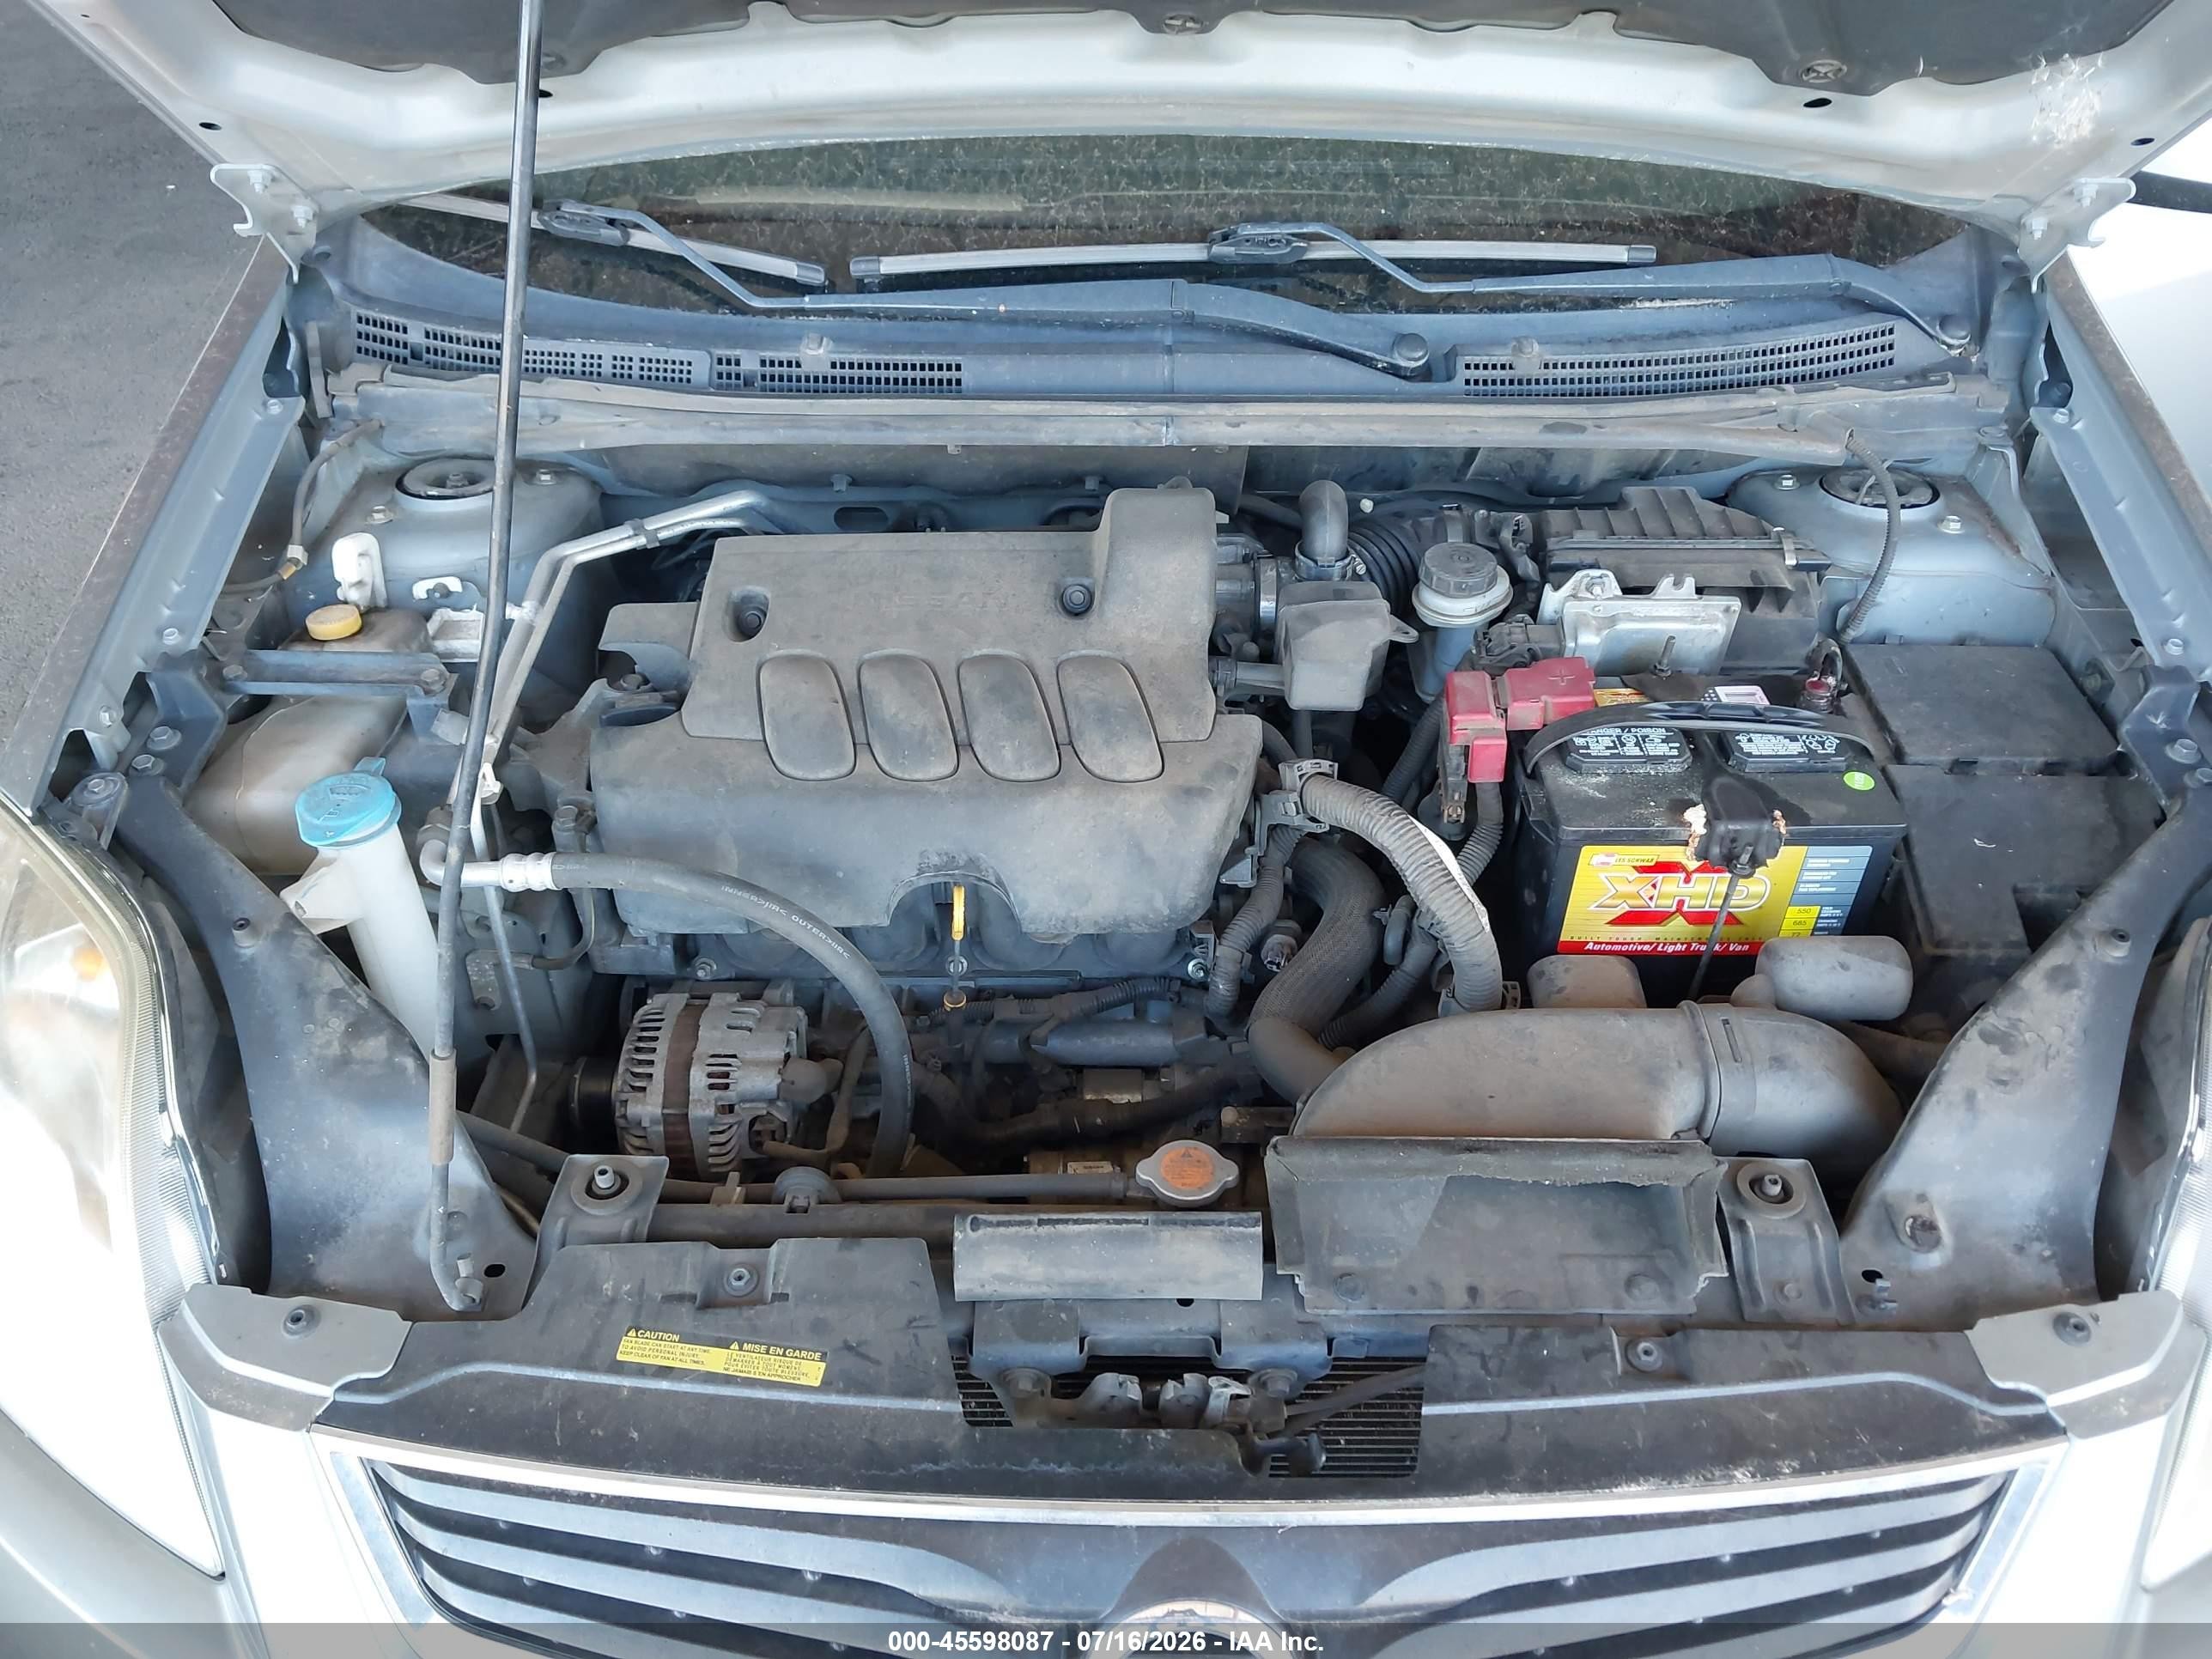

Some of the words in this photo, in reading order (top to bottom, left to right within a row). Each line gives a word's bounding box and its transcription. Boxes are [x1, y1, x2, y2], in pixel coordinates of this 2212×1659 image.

[1589, 873, 1771, 910] XHD
[1584, 942, 1657, 951] Automotive/
[1657, 943, 1687, 952] Light
[1690, 943, 1727, 951] Truk/
[1729, 943, 1750, 951] Van
[637, 1329, 680, 1342] CAUTION
[742, 1342, 768, 1353] MISE
[769, 1346, 783, 1355] EN
[785, 1348, 823, 1360] GARDE
